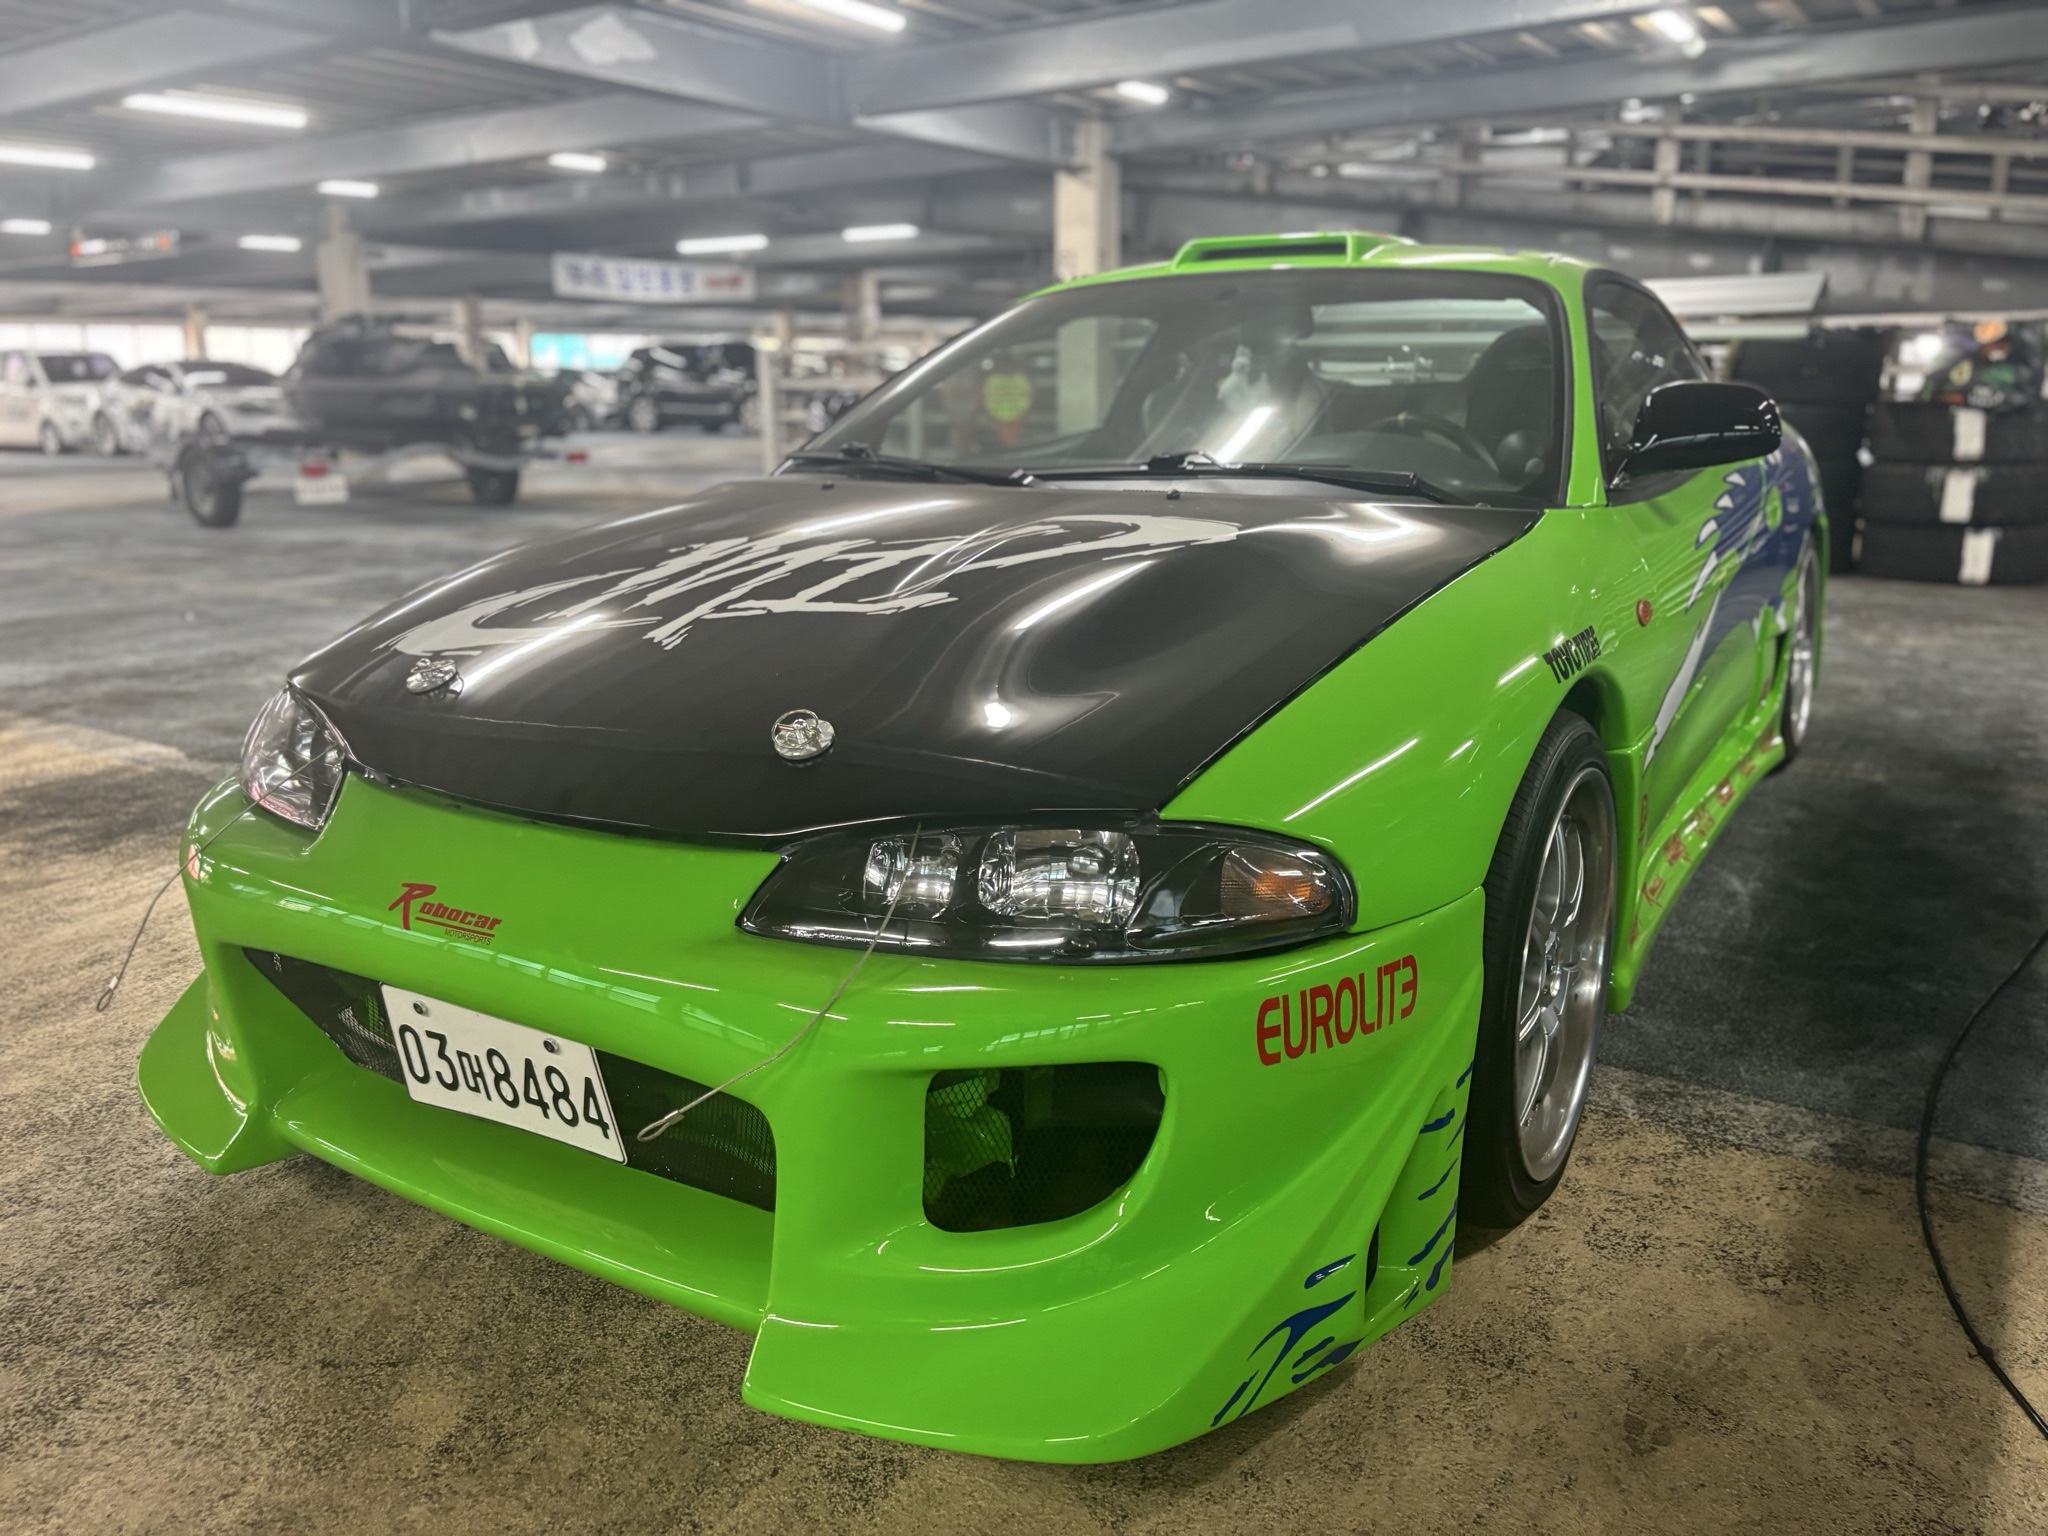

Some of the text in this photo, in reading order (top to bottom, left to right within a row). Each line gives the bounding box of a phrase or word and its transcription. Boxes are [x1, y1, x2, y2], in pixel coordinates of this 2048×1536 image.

[1542, 640, 1582, 684] TOYO
[388, 882, 502, 931] Robocar
[444, 928, 492, 946] MOTORSPORTS
[398, 1023, 611, 1140] 03머8484
